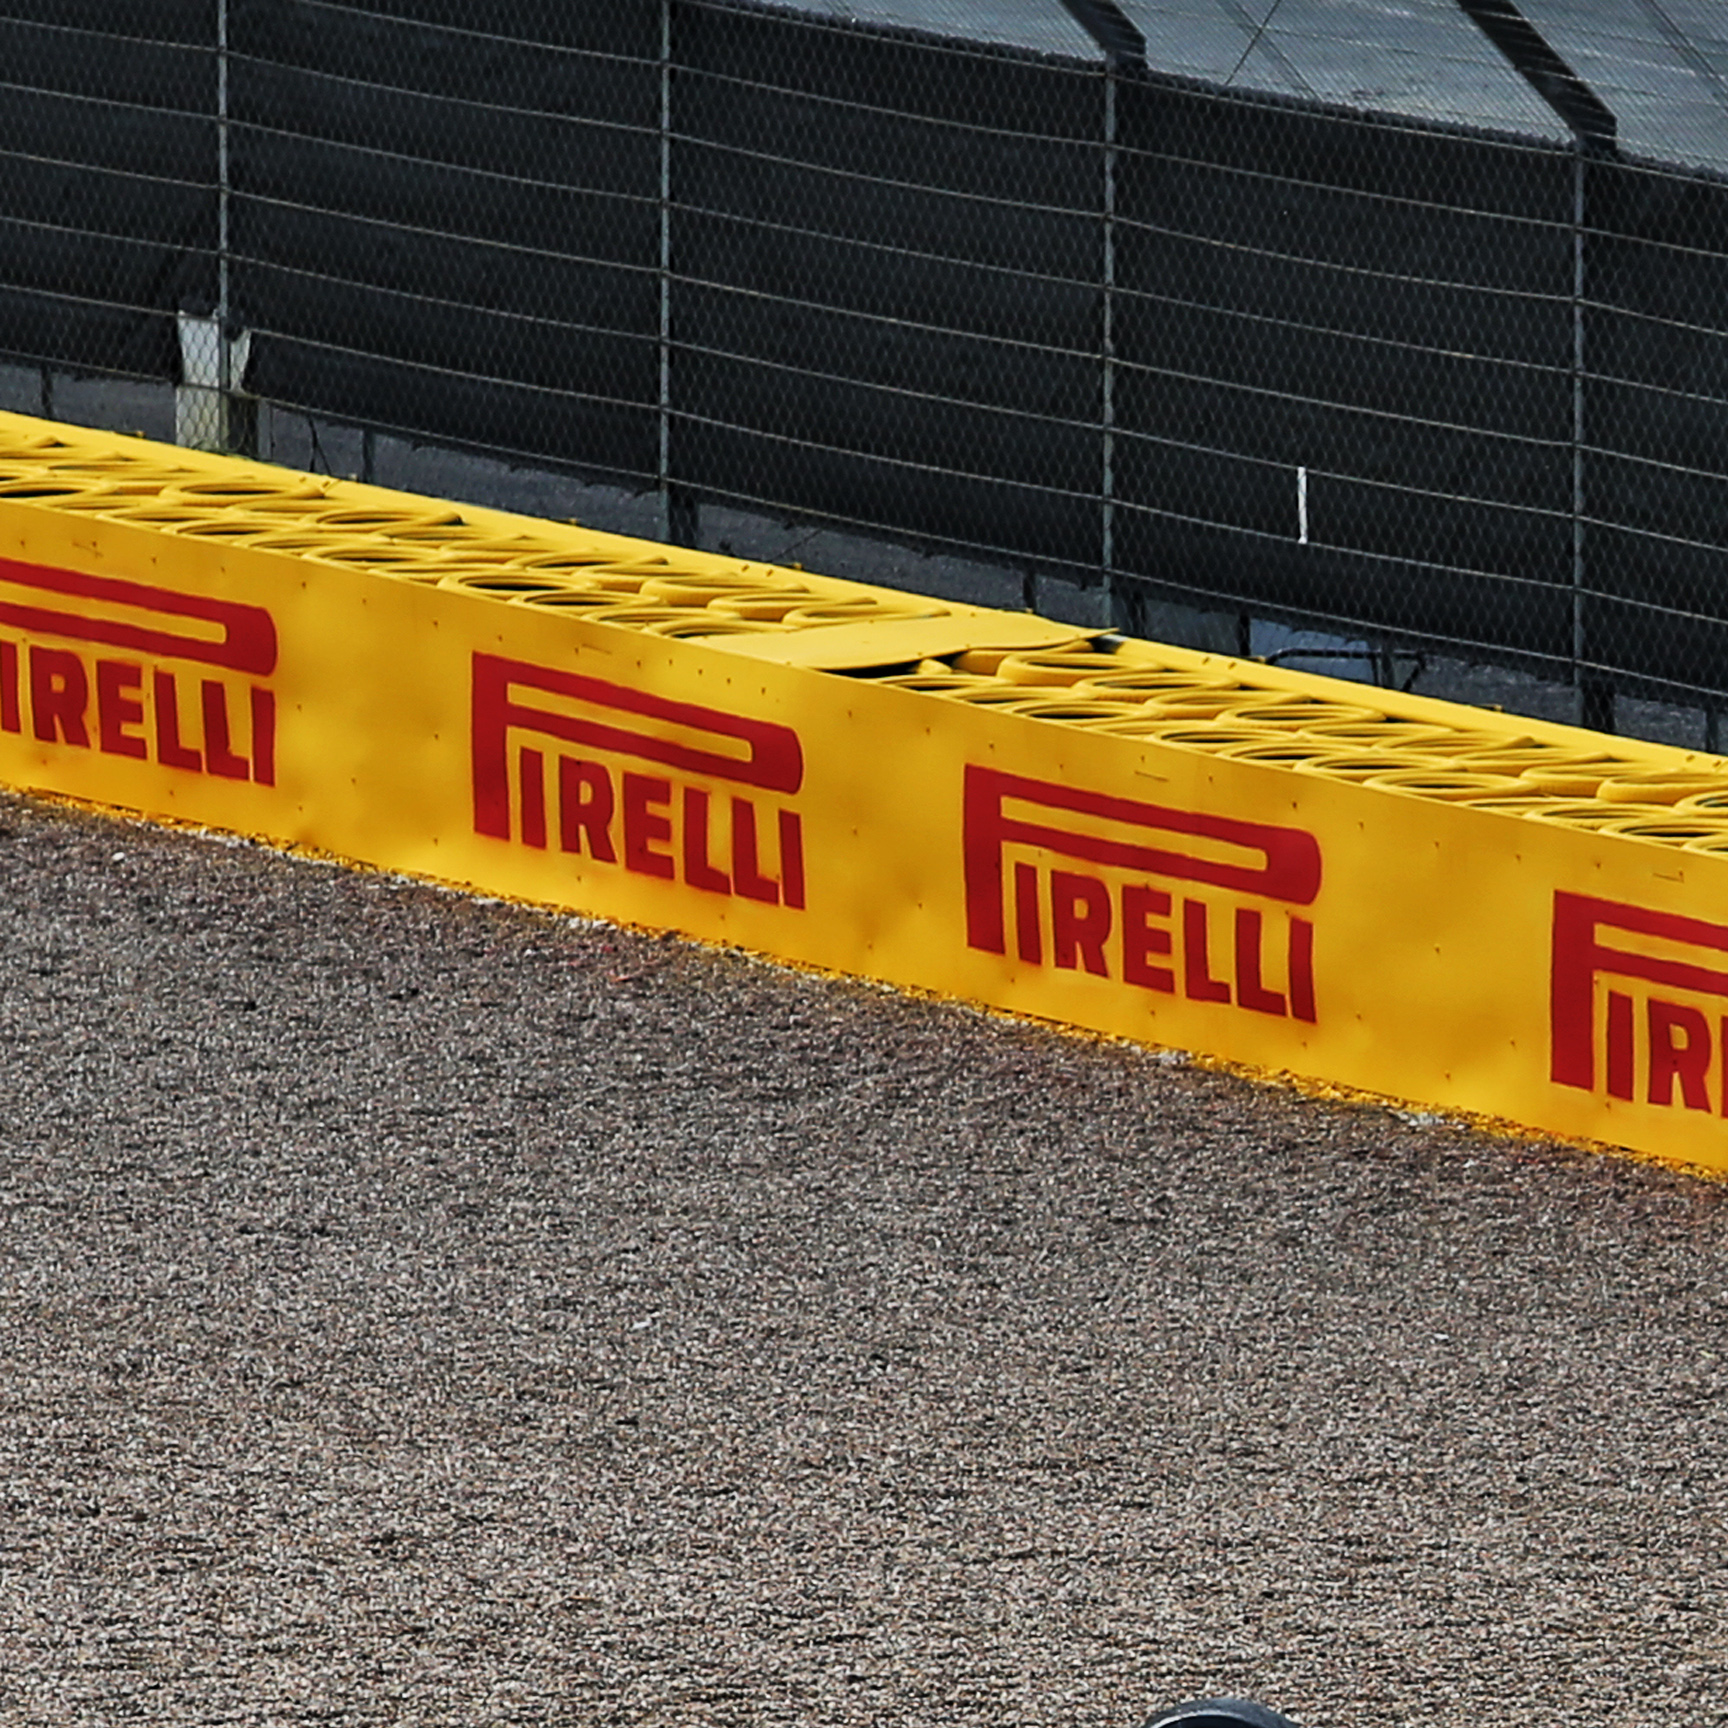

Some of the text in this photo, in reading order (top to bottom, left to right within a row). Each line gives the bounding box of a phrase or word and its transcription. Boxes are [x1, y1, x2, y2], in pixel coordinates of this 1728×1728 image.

[0, 557, 278, 787] PIRELLI
[471, 652, 806, 910] PIRELLI
[963, 764, 1322, 1024] PIRELLI
